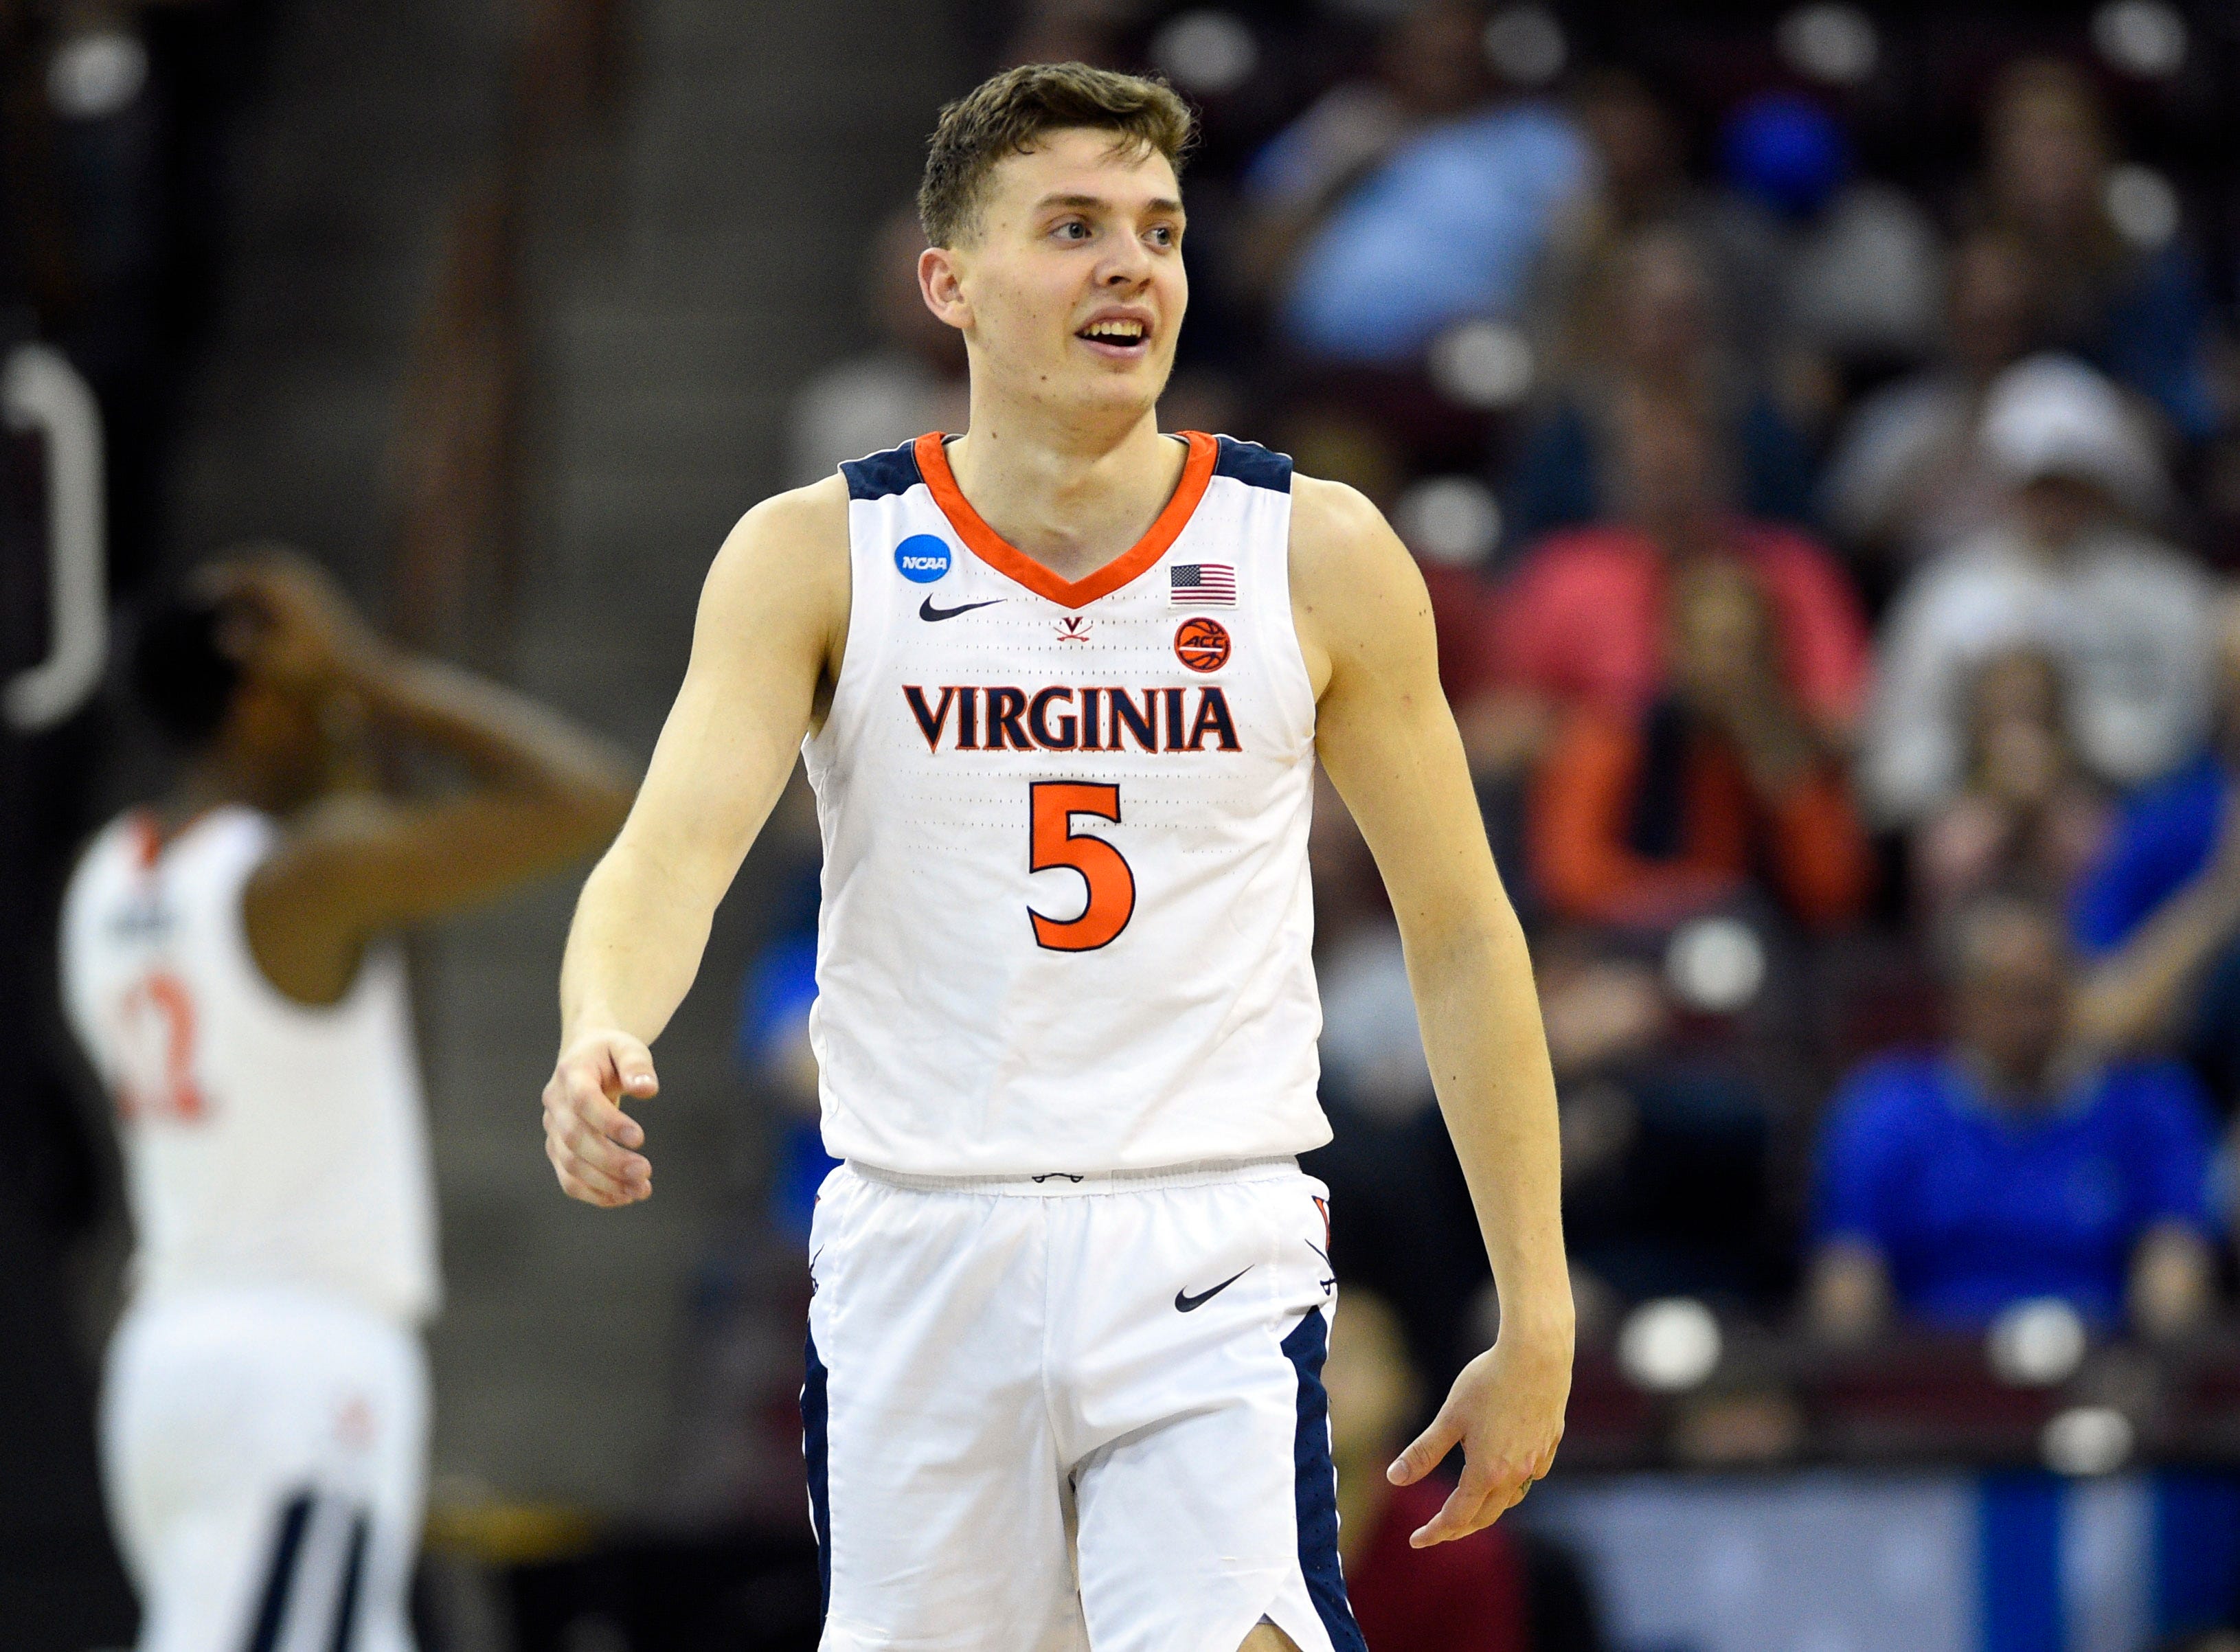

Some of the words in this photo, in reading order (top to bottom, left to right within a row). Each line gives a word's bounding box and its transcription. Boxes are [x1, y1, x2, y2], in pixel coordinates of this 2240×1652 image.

[903, 556, 947, 569] NCAA
[1182, 635, 1225, 648] ACC
[901, 685, 1242, 754] VIRGINIA
[1026, 780, 1136, 952] 5
